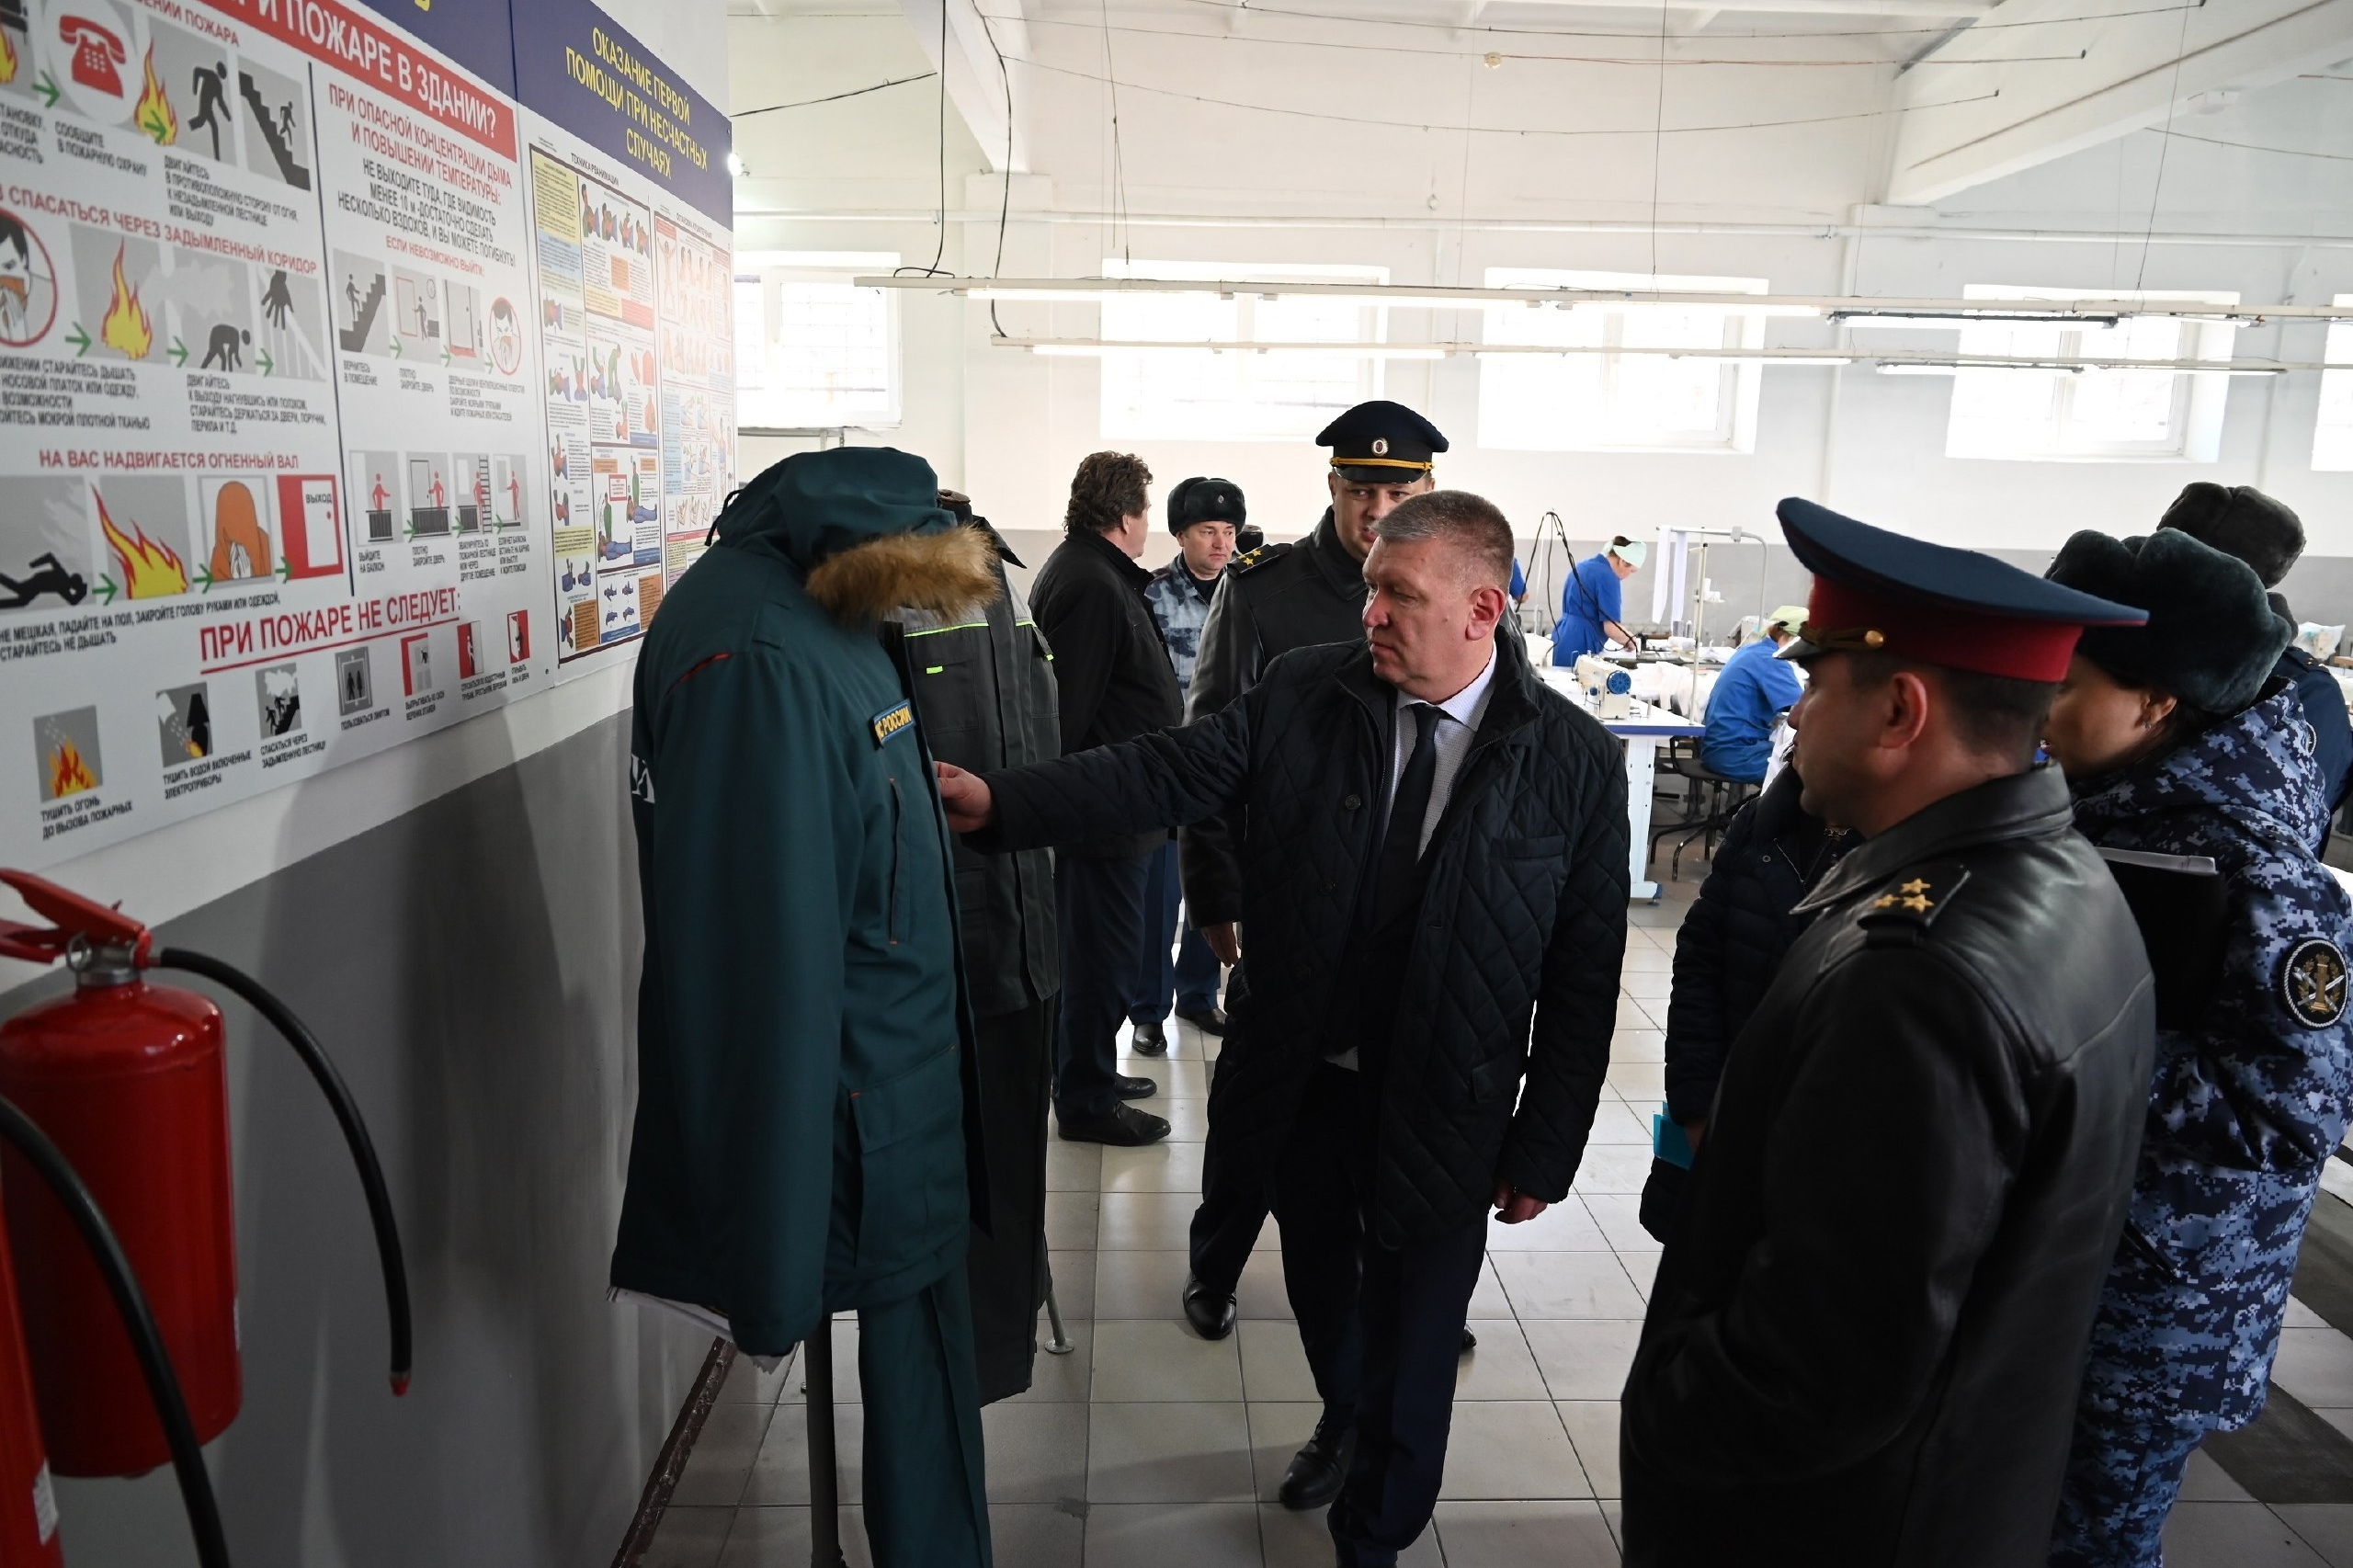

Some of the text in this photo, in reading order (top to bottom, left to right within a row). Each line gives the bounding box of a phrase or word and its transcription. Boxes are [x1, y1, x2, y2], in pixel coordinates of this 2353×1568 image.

[186, 10, 239, 47] ПОЖАРА
[285, 0, 497, 139] ПОЖАРЕ В ЗДАНИИ?
[592, 27, 691, 126] ОКАЗАНИЕ ПЕРВОЙ
[328, 83, 513, 189] ПРИ ОПАСНОЙ КОНЦЕНТРАЦИИ ДЫМА
[565, 46, 709, 173] ПОМОЩИ ПРИ НЕСЧАСТНЫХ
[351, 121, 362, 144] И
[363, 125, 435, 176] ПОВЫШЕНИИ
[436, 159, 503, 206] ТЕМПЕРАТУРЫ:
[626, 128, 672, 180] СЛУЧАЯХ
[363, 158, 496, 227] НЕ ВЫХОДИТЕ ТУДА, ГДЕ ВИДИМОСТЬ
[369, 182, 398, 207] МЕНЕЕ
[400, 195, 409, 210] 10
[465, 219, 494, 243] СДЕЛАТЬ
[9, 186, 109, 226] СПАСАТЬСЯ
[114, 212, 161, 239] ЧЕРЕЗ
[164, 224, 265, 262] ЗАДЫМЛЕННЫЙ
[267, 249, 317, 275] КОРИДОР
[337, 190, 392, 224] НЕСКОЛЬКО
[392, 210, 431, 240] ВЗДОХОВ,
[432, 223, 438, 240] И
[438, 225, 450, 244] ВЫ
[451, 231, 479, 255] МОЖЕТЕ
[386, 235, 408, 252] ЕСЛИ
[409, 243, 460, 269] НЕВОЗМОЖНО
[0, 355, 40, 371] ИЖЕНИИ
[39, 449, 299, 470] НА ВАС НАДВИГАЕТСЯ ОГНЕННЫЙ ВАЛ
[305, 494, 333, 506] ВЫХОД
[0, 631, 117, 661] СТАРАЙТЕСЬ НЕ ДЫШАТЬ
[200, 586, 461, 661] ПРИ ПОЖАРЕ НЕ СЛЕДУЕТ:
[882, 706, 913, 735] РОССИИ
[40, 795, 100, 822] ТУШИТЬ ОГОНЬ
[42, 801, 132, 841] ДО ВЫЗОВА ПОЖАРНЫХ
